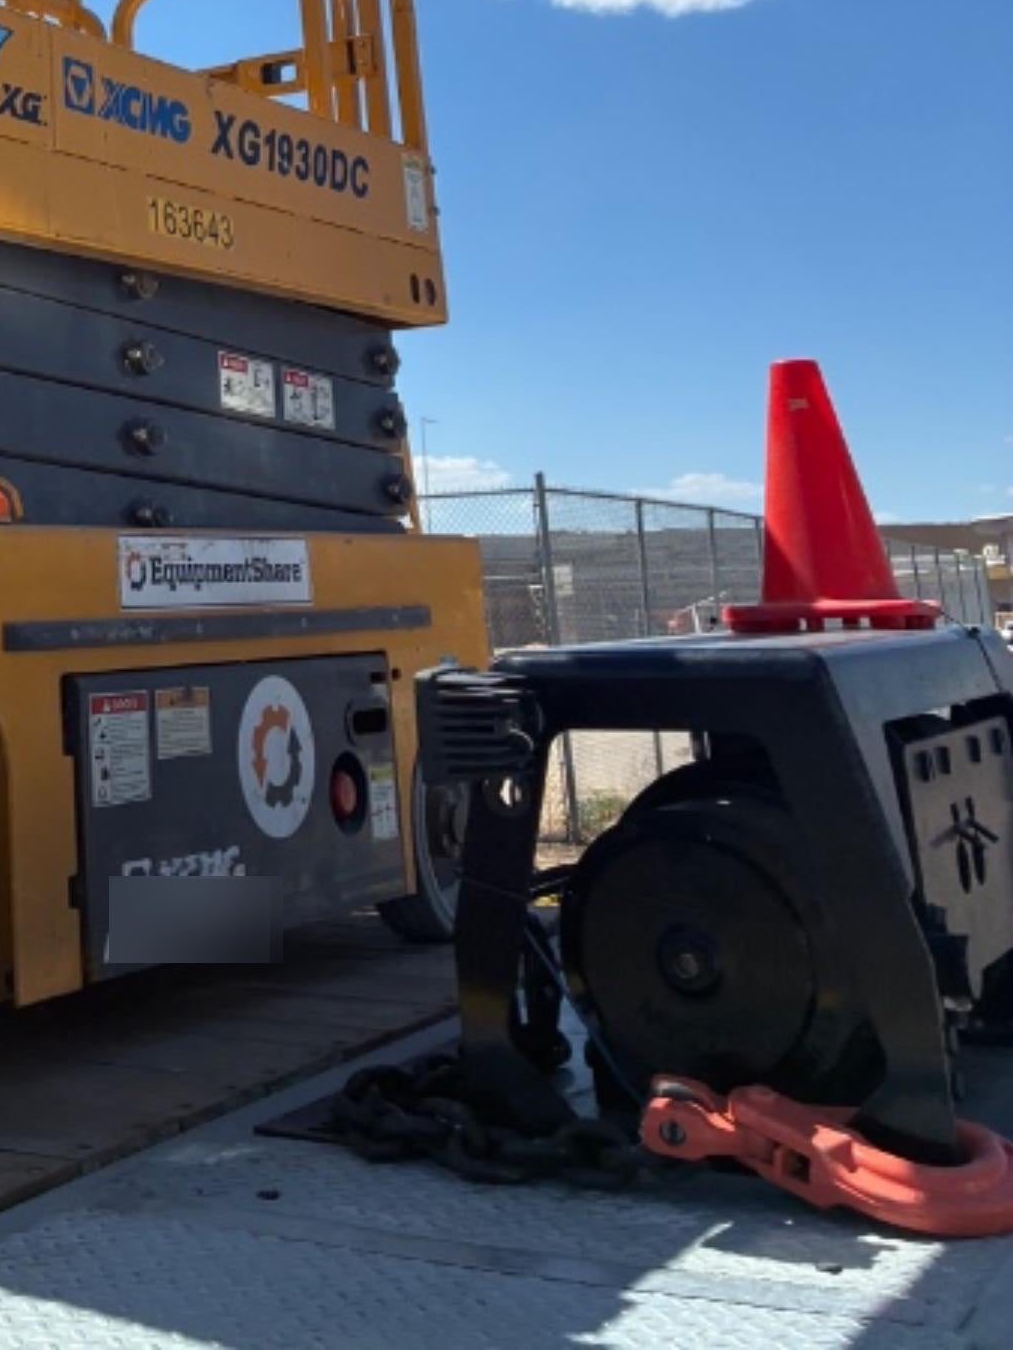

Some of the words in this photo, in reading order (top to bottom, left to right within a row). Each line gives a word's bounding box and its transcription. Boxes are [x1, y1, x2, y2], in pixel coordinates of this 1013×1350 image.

[211, 110, 370, 198] XG1930DC
[147, 199, 235, 250] 163643
[150, 556, 303, 592] EquipmentShare
